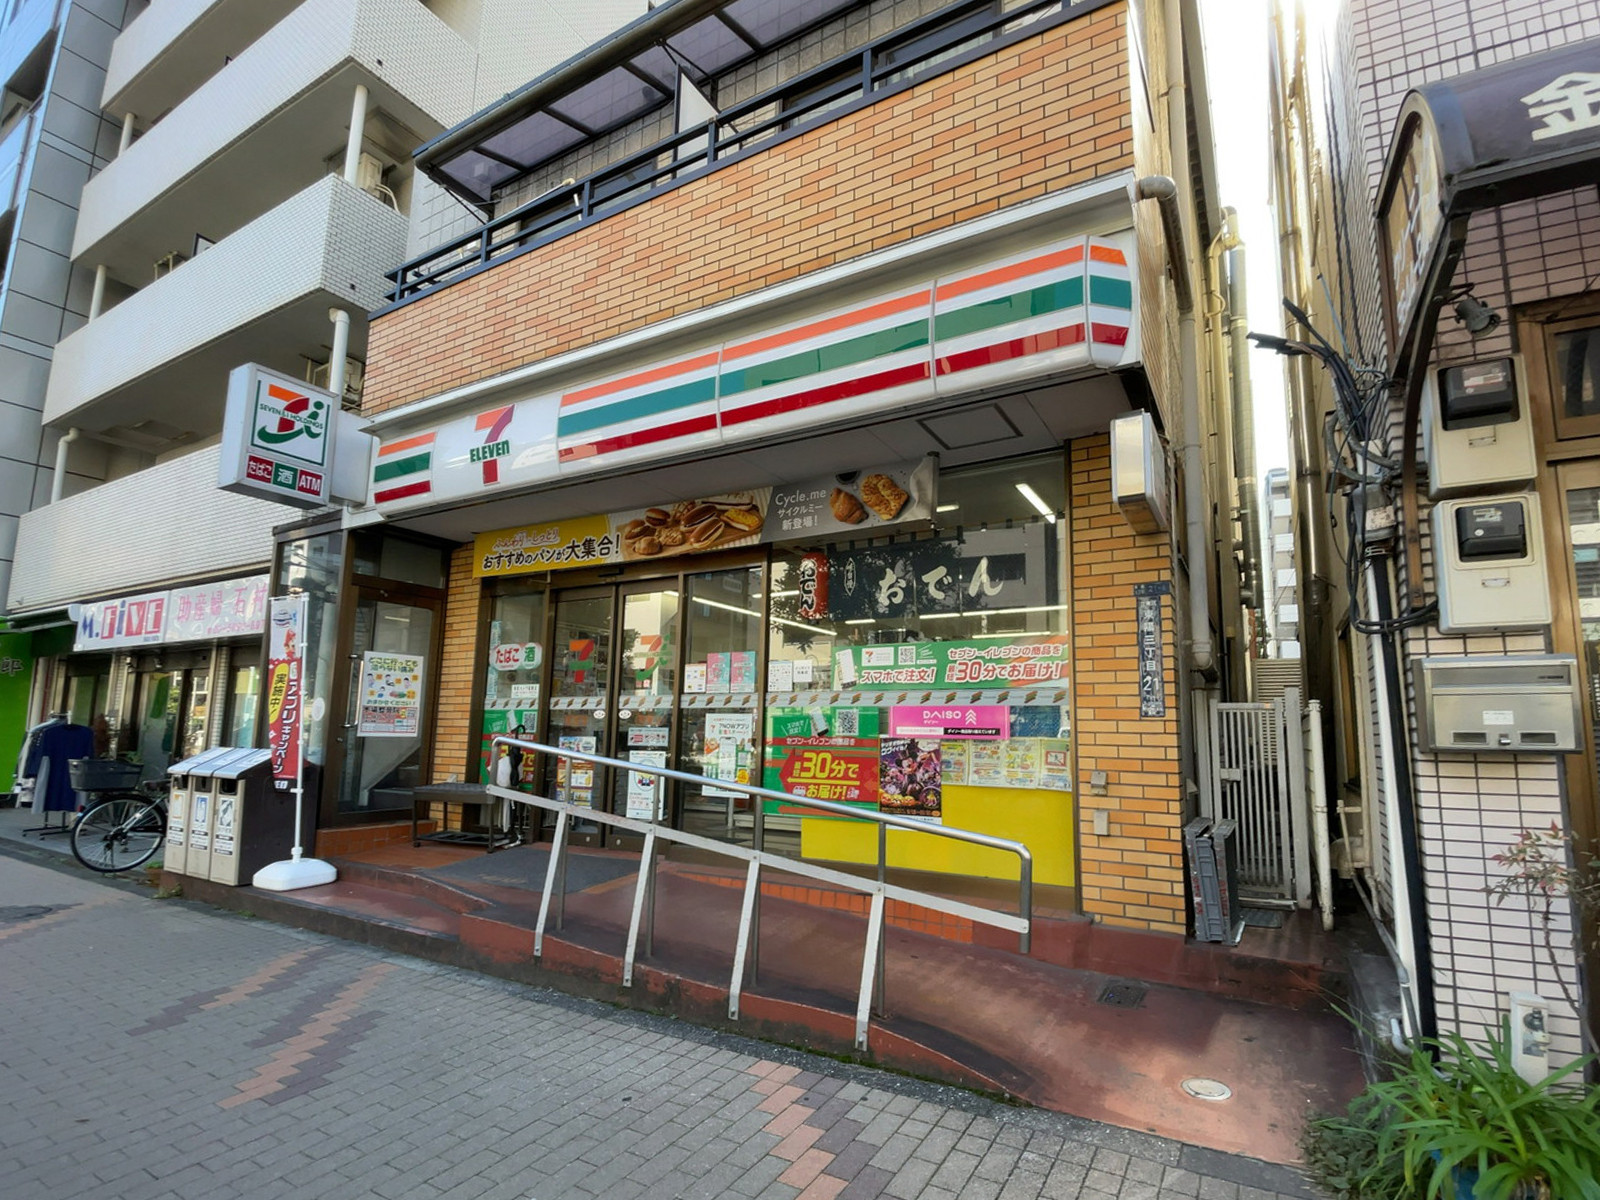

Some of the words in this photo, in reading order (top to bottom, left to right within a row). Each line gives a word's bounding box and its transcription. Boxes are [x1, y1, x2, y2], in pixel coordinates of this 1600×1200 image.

[290, 413, 324, 430] HOLDINGS
[248, 460, 272, 479] たばこ
[276, 467, 295, 485] 酒
[298, 474, 320, 492] ATM
[775, 489, 827, 508] Cycle.me
[777, 504, 824, 518] サイクルミー
[799, 559, 818, 611] おでん
[878, 556, 1004, 607] おでん
[495, 647, 519, 664] たばこ
[524, 646, 536, 662] 酒
[860, 667, 936, 685] スマホで注文!
[922, 710, 962, 720] DAISO
